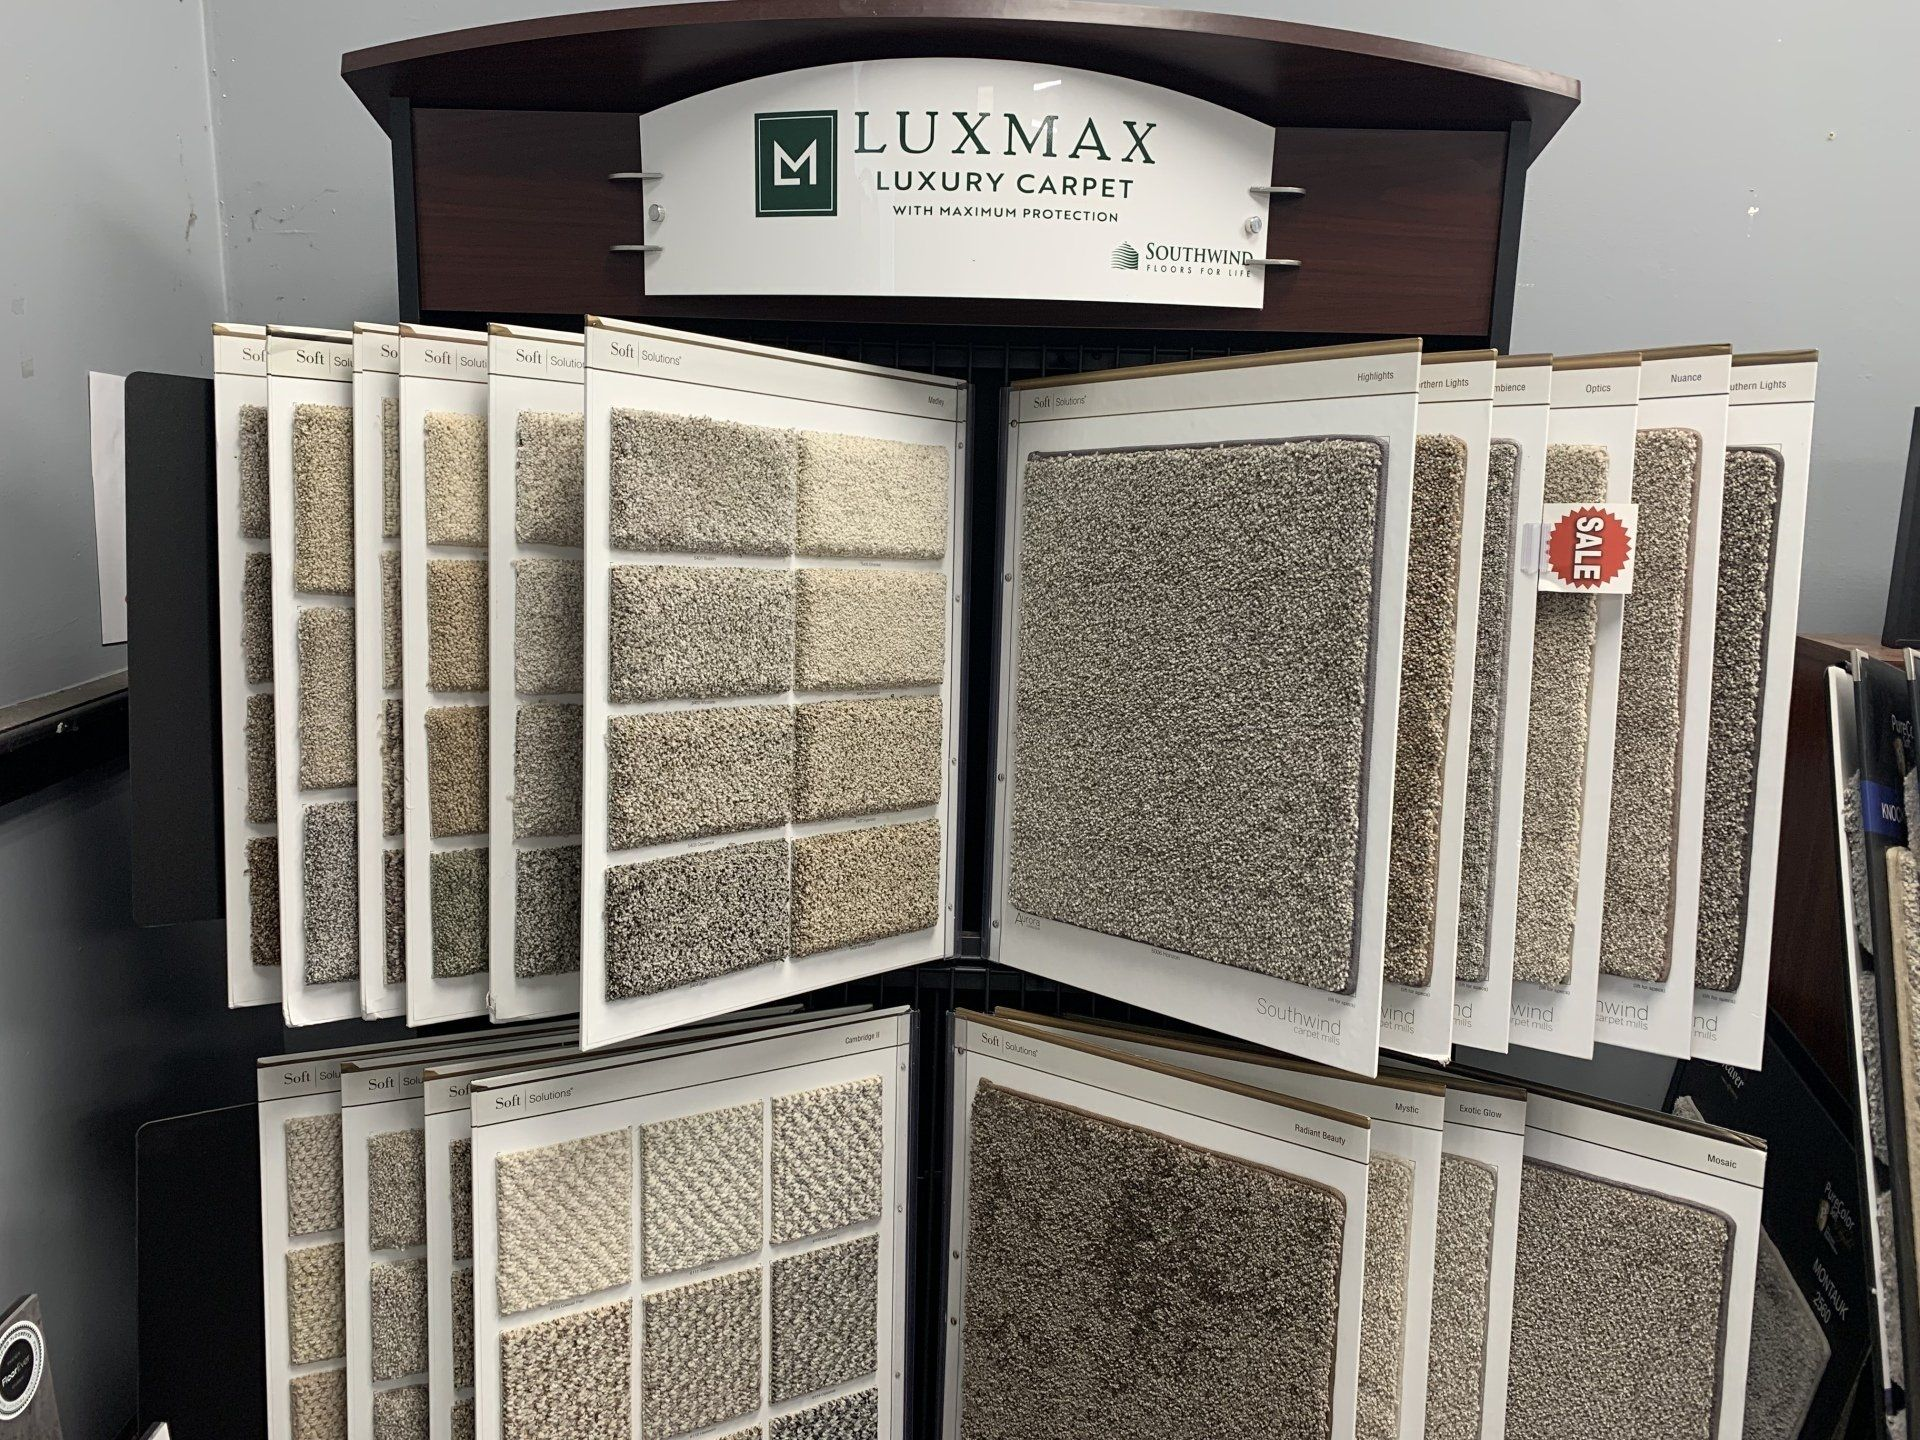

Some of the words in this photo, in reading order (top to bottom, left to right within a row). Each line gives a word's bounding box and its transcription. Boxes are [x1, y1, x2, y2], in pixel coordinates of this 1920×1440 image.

[854, 111, 1157, 164] LUXMAX
[876, 171, 1004, 192] LUXURY
[1016, 173, 1134, 199] CARPET
[893, 205, 933, 216] WITH
[940, 206, 1016, 219] MAXIMUM
[1023, 208, 1119, 223] PROTECTION
[1146, 264, 1192, 274] FLOORS
[1200, 267, 1220, 276] FOR
[1229, 269, 1250, 278] LIFE
[242, 347, 266, 362] Sof
[296, 350, 324, 365] Soft
[381, 345, 398, 359] So
[610, 341, 634, 359] Soft
[424, 350, 451, 365] Soft
[460, 357, 487, 368] Soluti
[516, 349, 542, 365] Soft
[550, 356, 584, 369] Solutio
[1357, 371, 1394, 382] Highlights
[1419, 379, 1443, 388] rthern
[1446, 379, 1469, 389] Lights
[1670, 373, 1702, 383] Nuance
[1494, 383, 1526, 392] mbience
[1585, 384, 1611, 393] Optics
[1730, 381, 1757, 391] uthern
[1760, 380, 1787, 392] Lights
[1033, 396, 1051, 409] Soft
[1573, 516, 1604, 580] SALE
[1881, 802, 1902, 822] KNOC
[1256, 997, 1341, 1036] Southwind
[1511, 1002, 1553, 1023] wind
[1394, 1022, 1415, 1035] mills
[1511, 1017, 1530, 1028] rpet
[1531, 1020, 1553, 1032] mills
[1626, 1018, 1649, 1031] mills
[845, 1033, 874, 1045] Cambridge
[981, 1032, 999, 1047] Soft
[1293, 1025, 1320, 1041] carpet
[1321, 1032, 1341, 1046] mills
[1694, 1031, 1717, 1042] mills
[284, 1071, 311, 1086] Soft
[319, 1071, 341, 1081] Solu
[368, 1076, 395, 1092] Soft
[403, 1076, 424, 1086] Solu
[449, 1084, 471, 1098] Sof
[495, 1095, 521, 1110] Soft
[1395, 1102, 1420, 1114] Mystic
[1459, 1104, 1482, 1115] Exotic
[1483, 1108, 1502, 1119] Glow
[1294, 1123, 1321, 1139] Radiant
[1322, 1131, 1346, 1146] Beauty
[1707, 1154, 1737, 1169] Mosaic
[1823, 1181, 1855, 1231] PureColor
[1812, 1257, 1849, 1321] MONTAUK
